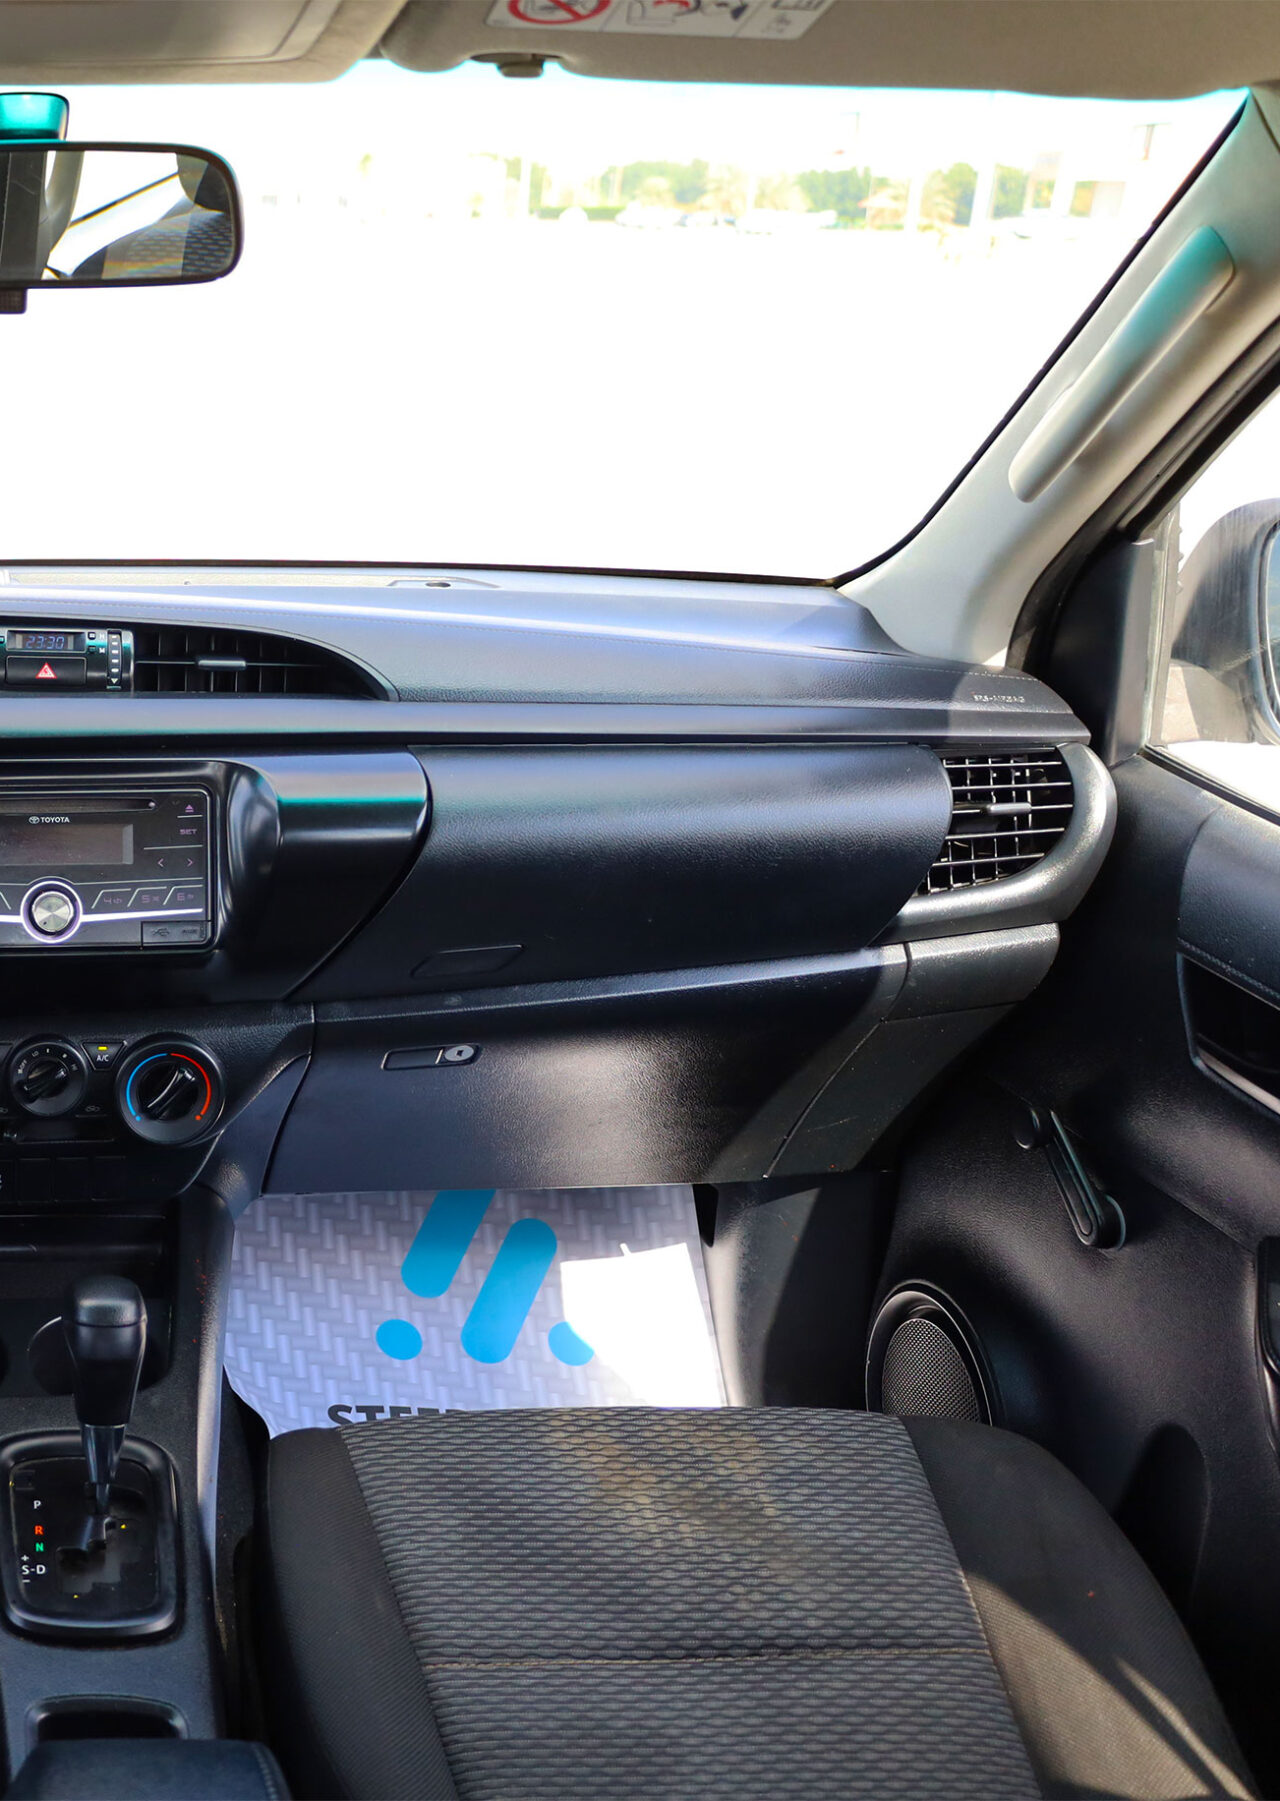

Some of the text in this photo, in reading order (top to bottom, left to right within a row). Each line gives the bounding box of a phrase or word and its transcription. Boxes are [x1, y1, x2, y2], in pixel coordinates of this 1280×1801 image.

[40, 816, 70, 824] TOYOTA
[179, 828, 197, 836] SET
[96, 1054, 109, 1062] A/C
[33, 1501, 41, 1509] P
[34, 1525, 43, 1535] R
[36, 1543, 44, 1551] N
